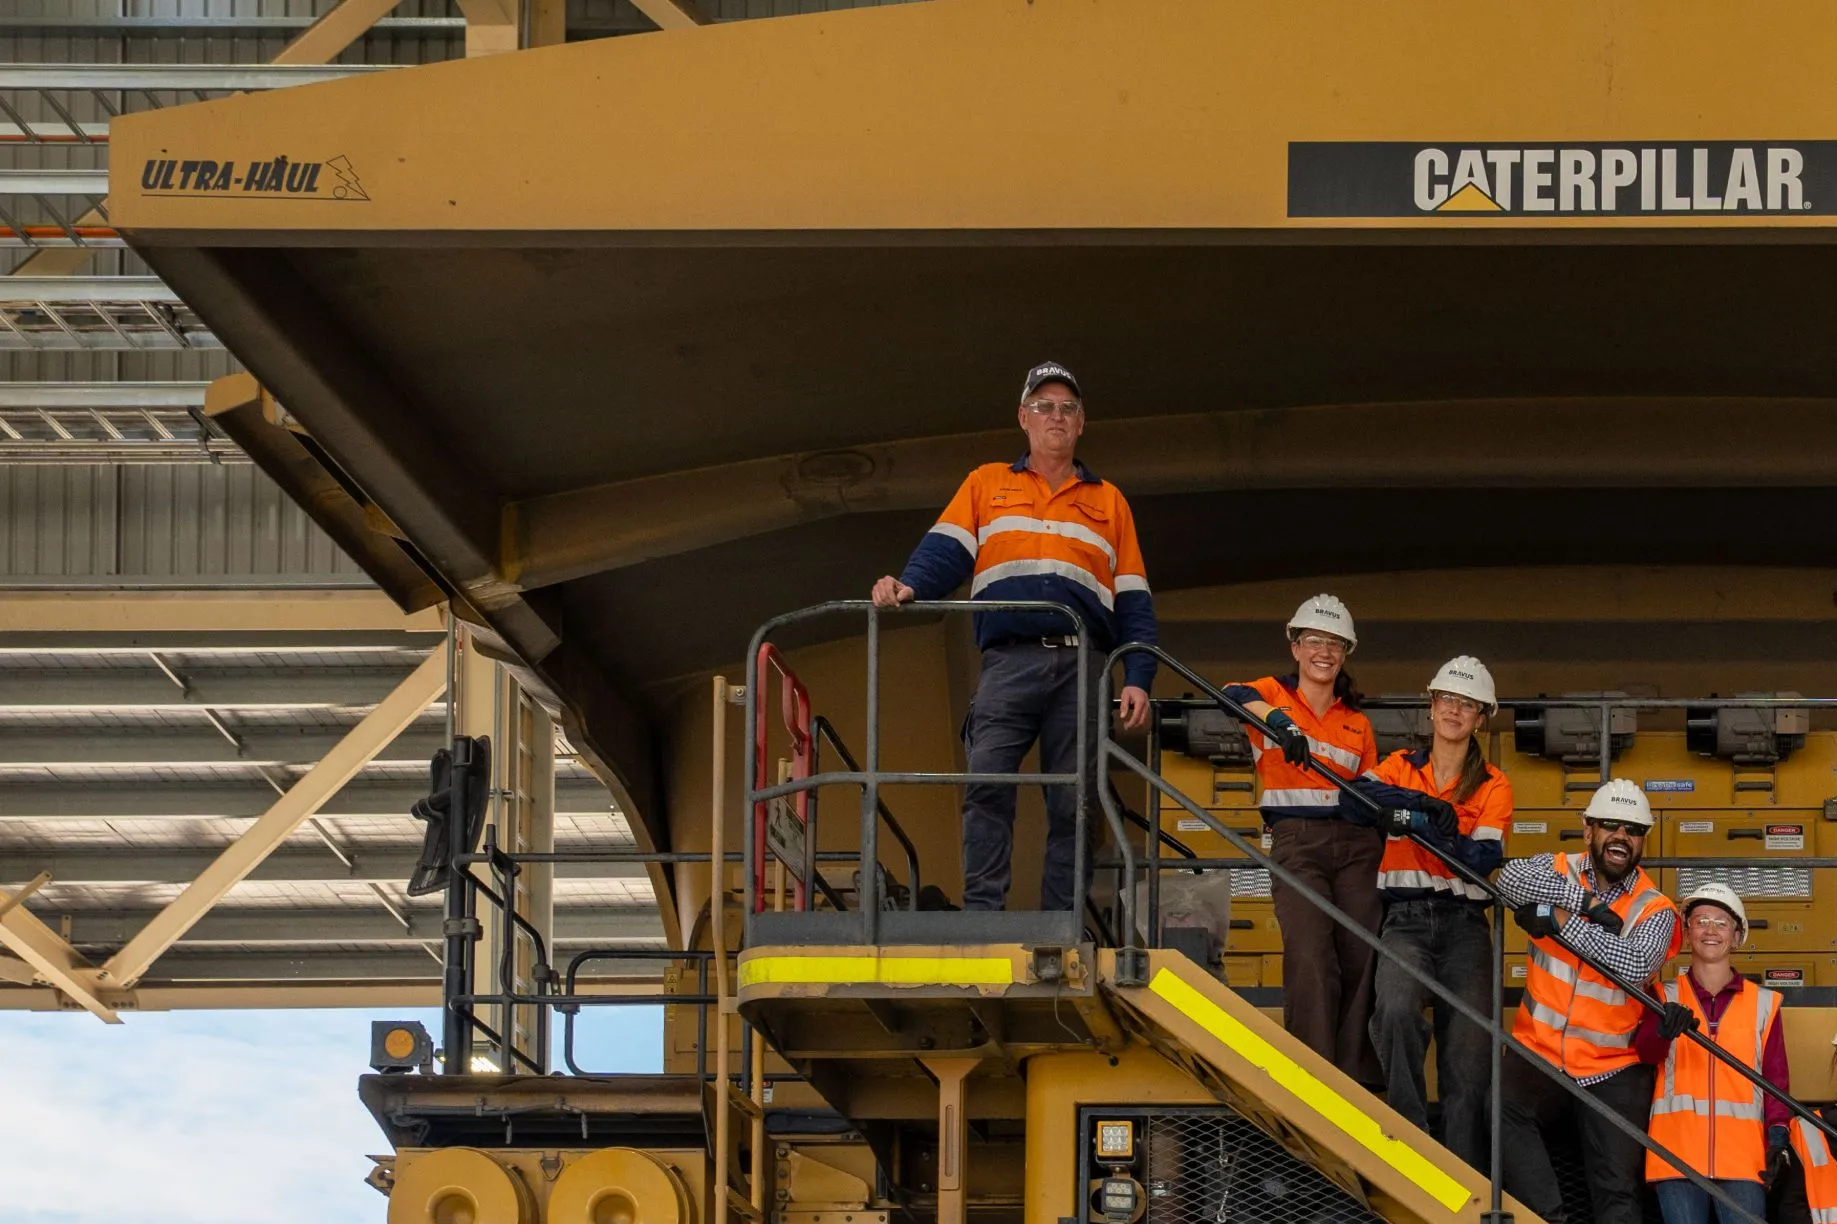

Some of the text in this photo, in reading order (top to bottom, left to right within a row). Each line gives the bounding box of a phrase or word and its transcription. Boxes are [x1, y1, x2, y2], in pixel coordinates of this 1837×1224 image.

[141, 159, 322, 193] ULTRA-HAUL
[1413, 148, 1804, 212] CATERPILLAR
[1315, 608, 1340, 619] BRAVUS
[1448, 669, 1474, 680] BRAVUS
[1611, 796, 1637, 806] BRAVUS
